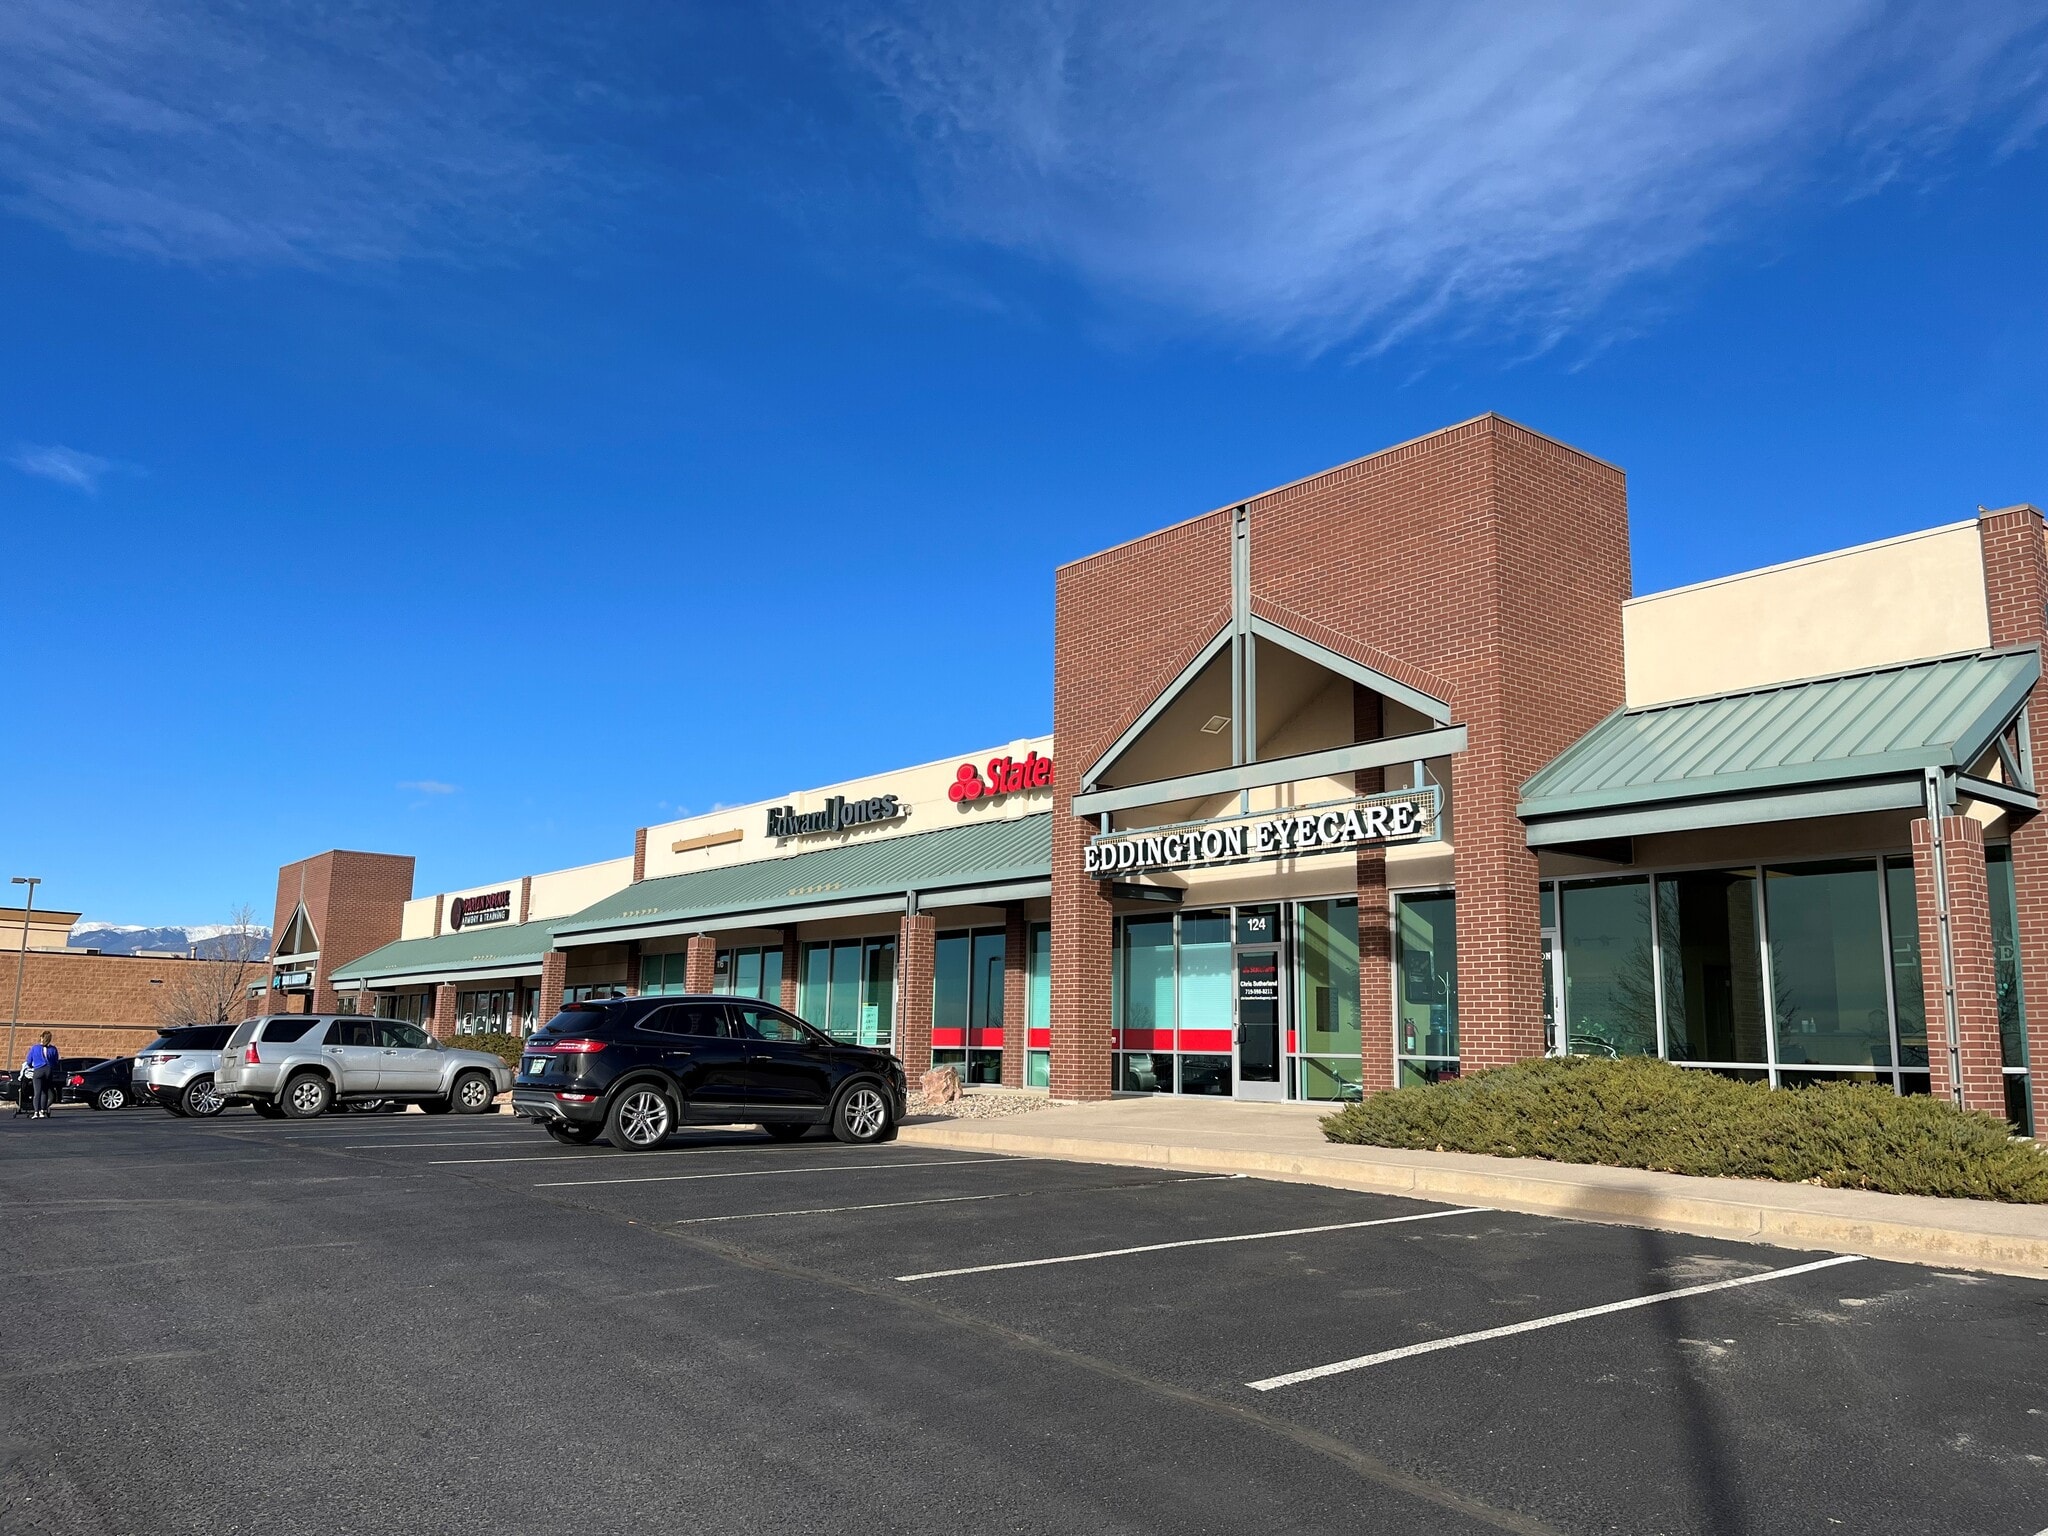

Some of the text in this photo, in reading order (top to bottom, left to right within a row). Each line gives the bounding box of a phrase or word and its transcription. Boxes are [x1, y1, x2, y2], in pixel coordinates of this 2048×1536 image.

[1084, 801, 1417, 873] EDDINGTON EYECARE
[1247, 917, 1267, 931] 124
